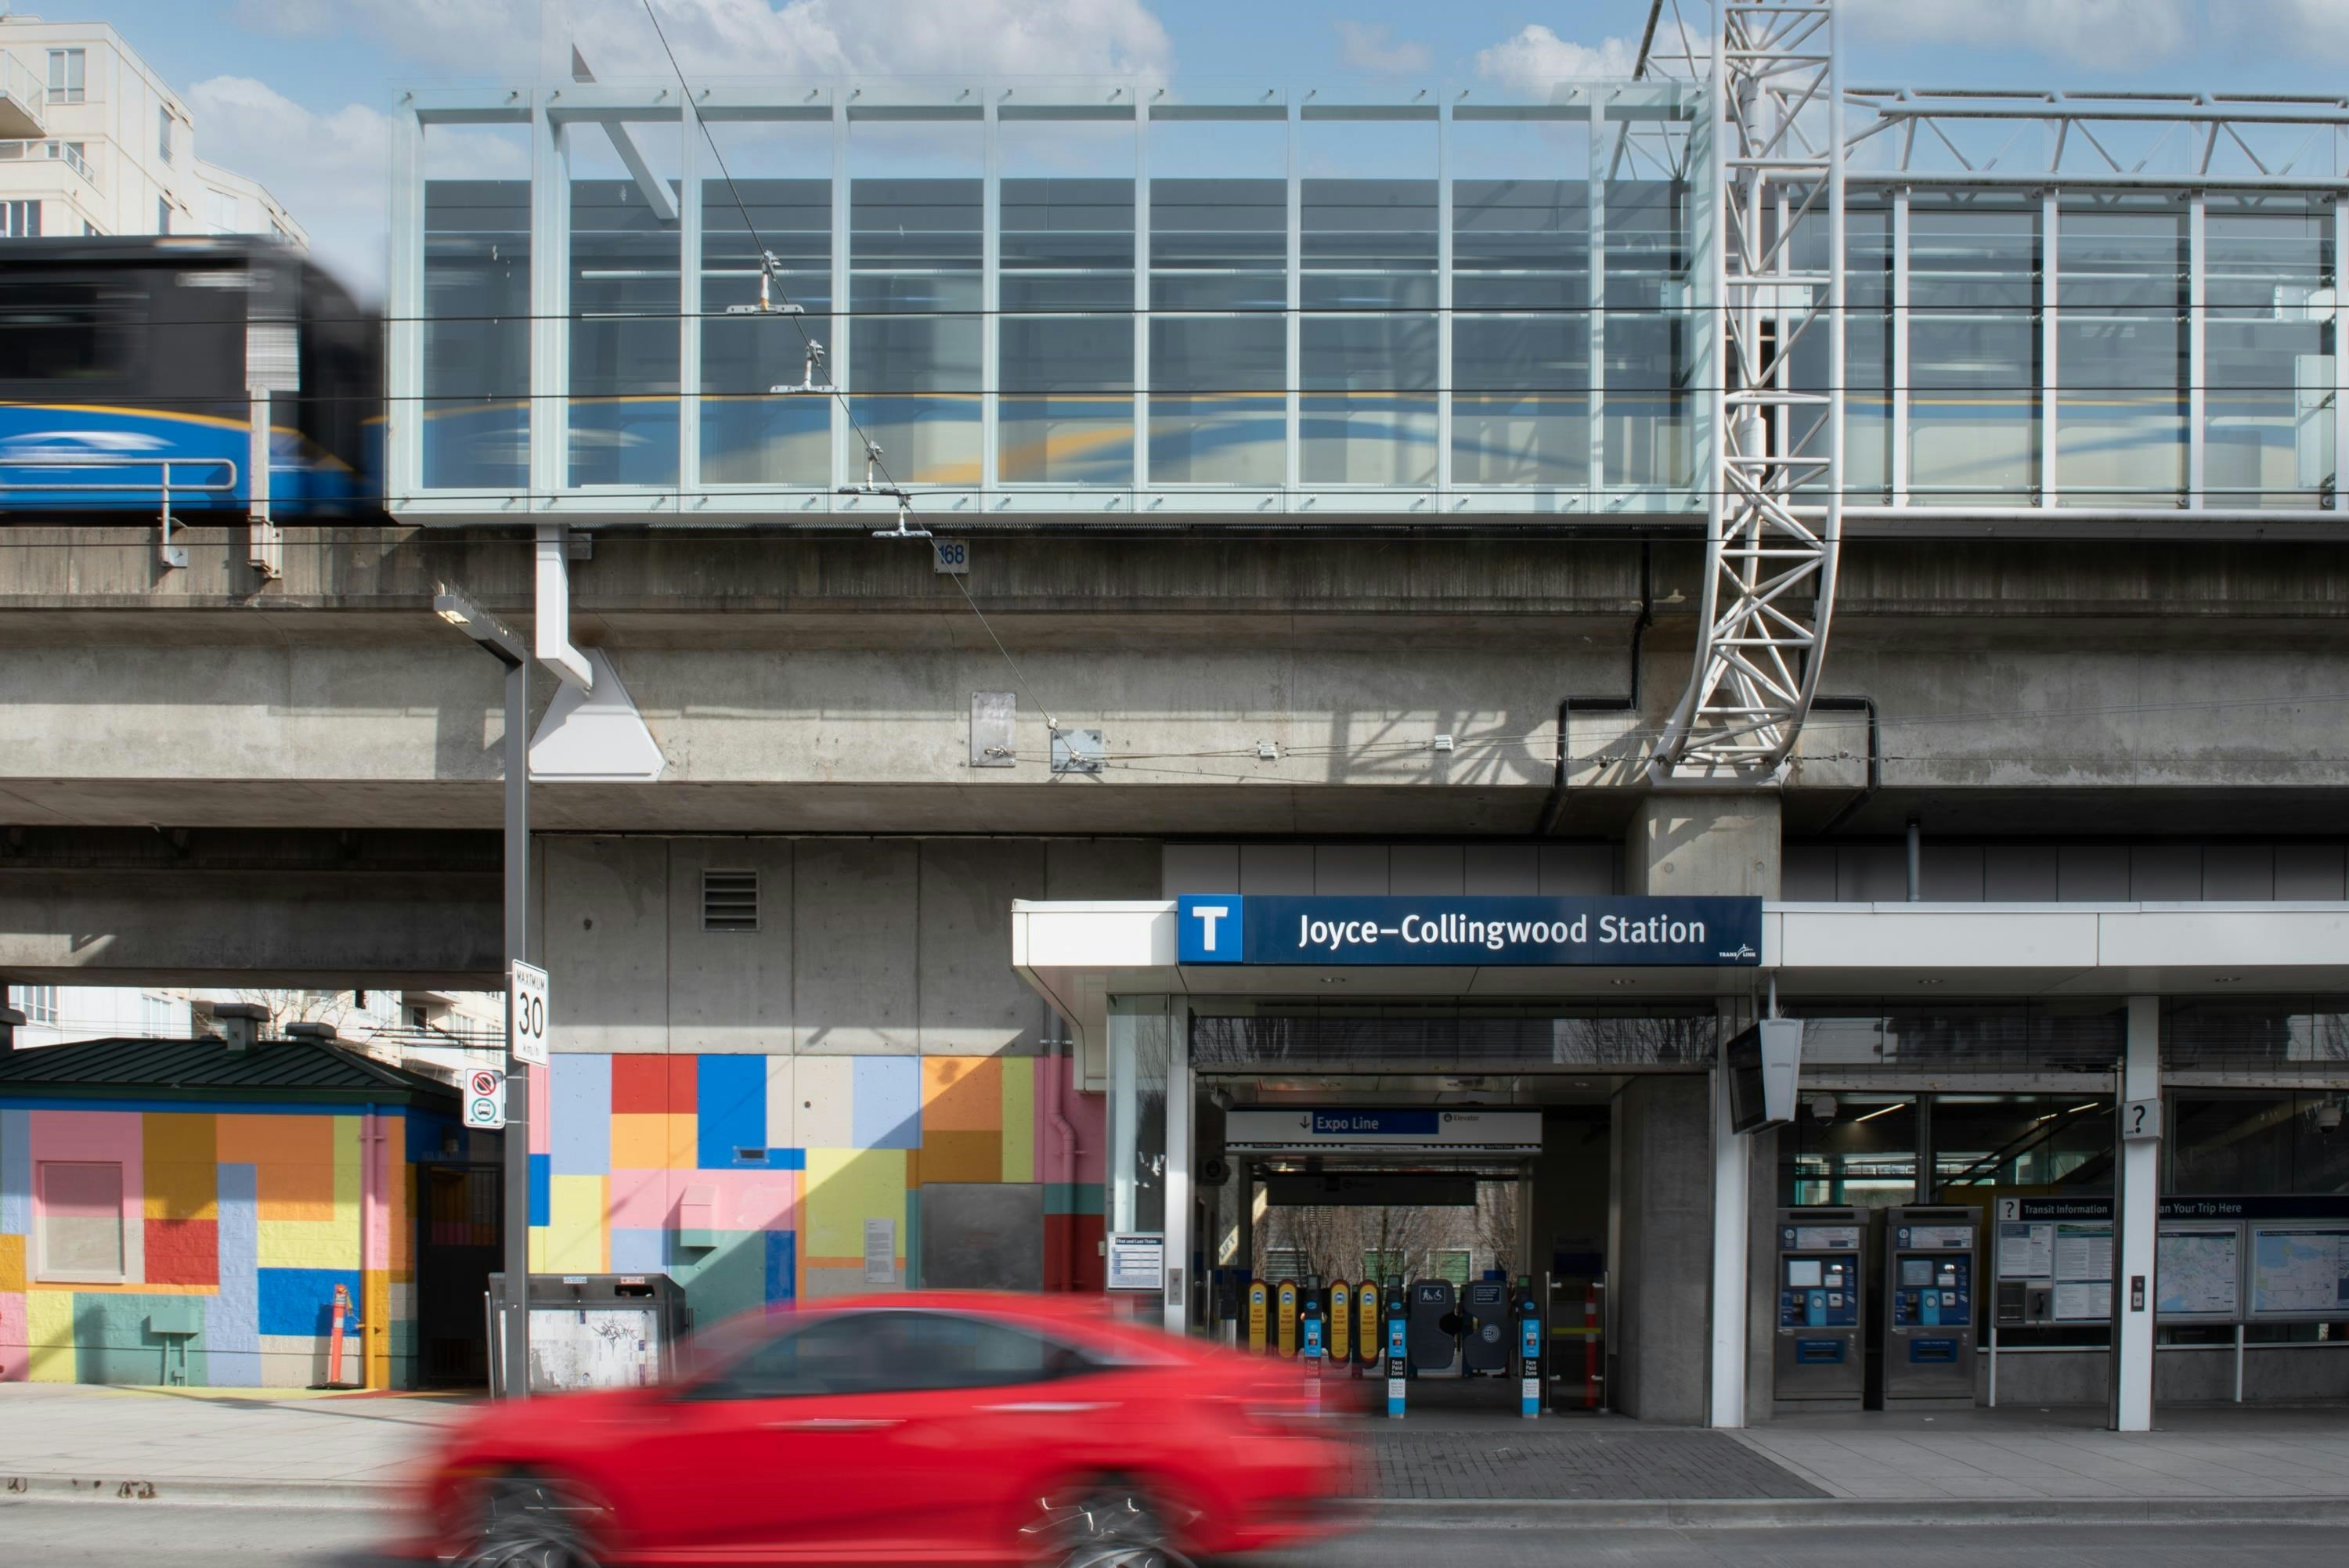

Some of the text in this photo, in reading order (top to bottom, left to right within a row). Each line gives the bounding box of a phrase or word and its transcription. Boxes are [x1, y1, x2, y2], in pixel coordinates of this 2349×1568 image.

[940, 544, 965, 564] 168
[1599, 914, 1705, 943] Station
[517, 969, 546, 990] MAXIMUM
[519, 991, 543, 1040] 30
[1317, 1117, 1380, 1131] Expo Line
[2024, 1204, 2055, 1214] Transit
[2057, 1204, 2109, 1214] Information
[2158, 1202, 2243, 1215] an Your Trip Here
